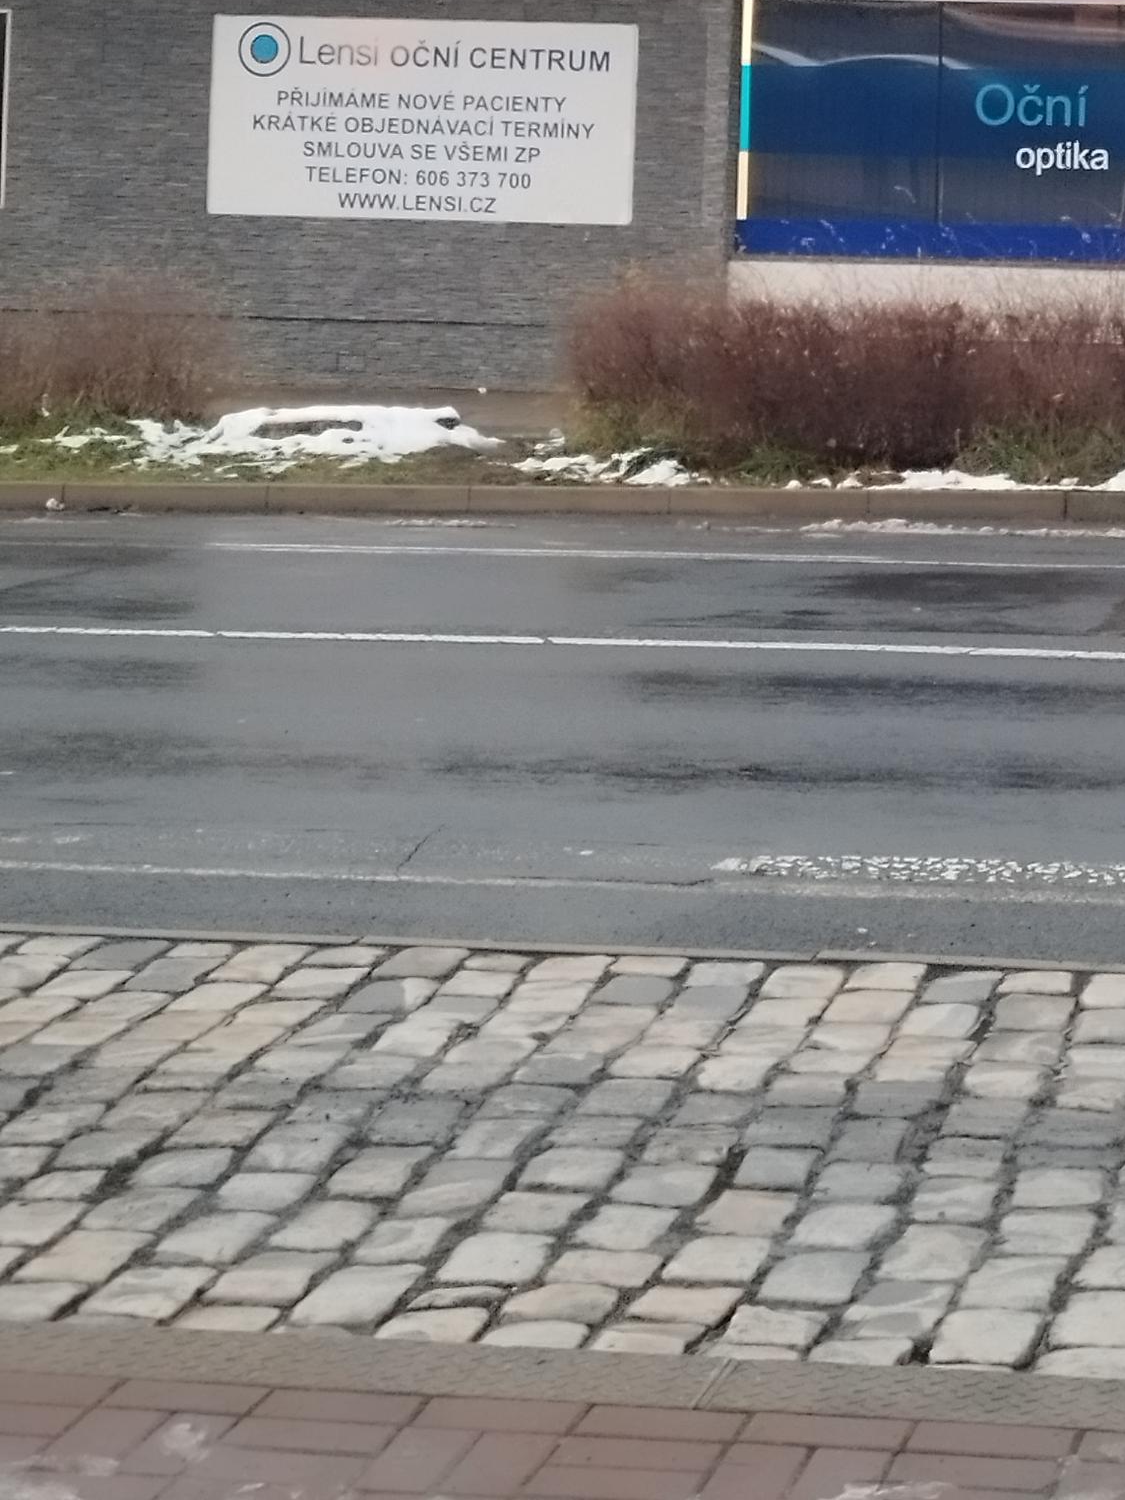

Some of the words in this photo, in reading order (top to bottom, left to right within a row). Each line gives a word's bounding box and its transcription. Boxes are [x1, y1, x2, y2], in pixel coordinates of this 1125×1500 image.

[299, 35, 379, 67] Lensi
[390, 39, 461, 69] OČNÍ
[469, 47, 611, 73] CENTRUM
[276, 86, 390, 109] PŘIJÍMÁME
[398, 90, 456, 111] NOVÉ
[463, 95, 567, 113] PACIENTY
[974, 84, 1089, 128] Oční
[252, 111, 337, 133] KRÁTKÉ
[344, 116, 494, 136] OBJEDNÁVACÍ
[501, 119, 595, 139] TERMÍNY
[303, 141, 404, 160] SMLOUVA
[410, 144, 437, 161] SE
[444, 141, 508, 163] VŠEMI
[515, 146, 541, 163] ZP
[1015, 140, 1110, 175] optika
[305, 166, 408, 186] TELEFON:
[416, 169, 450, 187] 606
[456, 171, 490, 189] 373
[498, 173, 532, 190] 700
[338, 192, 497, 214] WWW.LENSI.CZ
